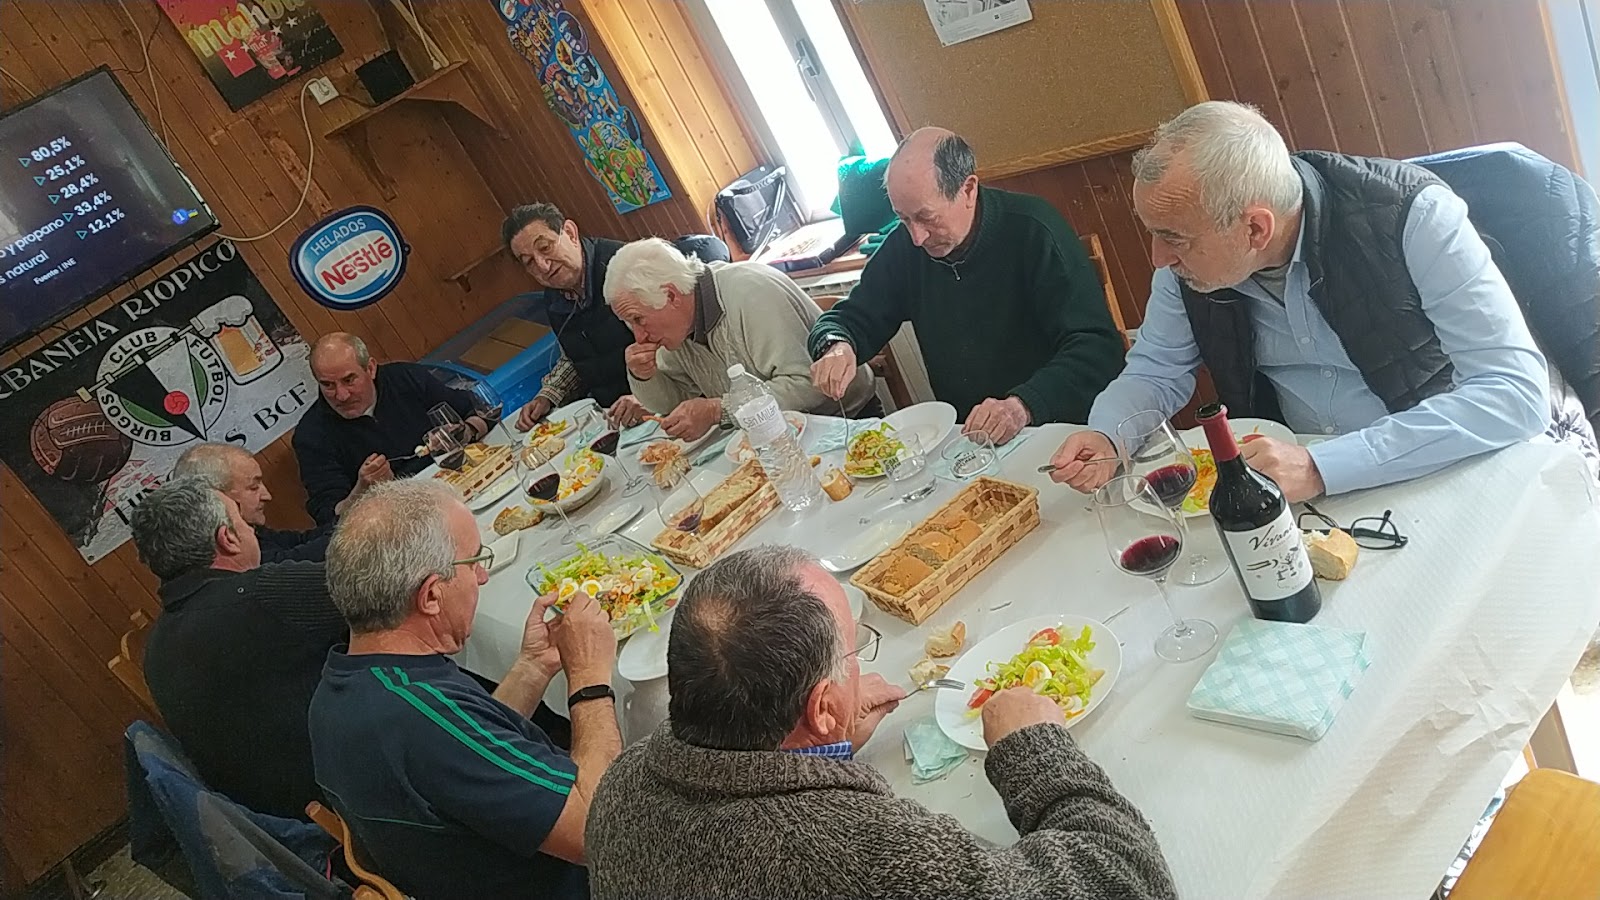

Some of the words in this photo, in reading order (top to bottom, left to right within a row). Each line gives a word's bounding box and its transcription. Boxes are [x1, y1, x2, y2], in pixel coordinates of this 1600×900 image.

[31, 136, 72, 161] 80,5%
[45, 154, 86, 180] 25,1%
[60, 172, 99, 199] 28,4%
[5, 244, 17, 256] y
[15, 218, 65, 252] propano
[74, 190, 113, 216] 33,4%
[5, 249, 50, 279] natural
[88, 207, 126, 234] 12,1%
[310, 218, 367, 256] HELADOS
[33, 268, 60, 285] Fuente
[120, 239, 236, 322] RIOPICO
[320, 235, 393, 291] Nestlé
[109, 331, 158, 364] CLUB
[190, 338, 224, 406] FUTBOL
[101, 393, 171, 441] BURGOS
[253, 381, 307, 431] BCF
